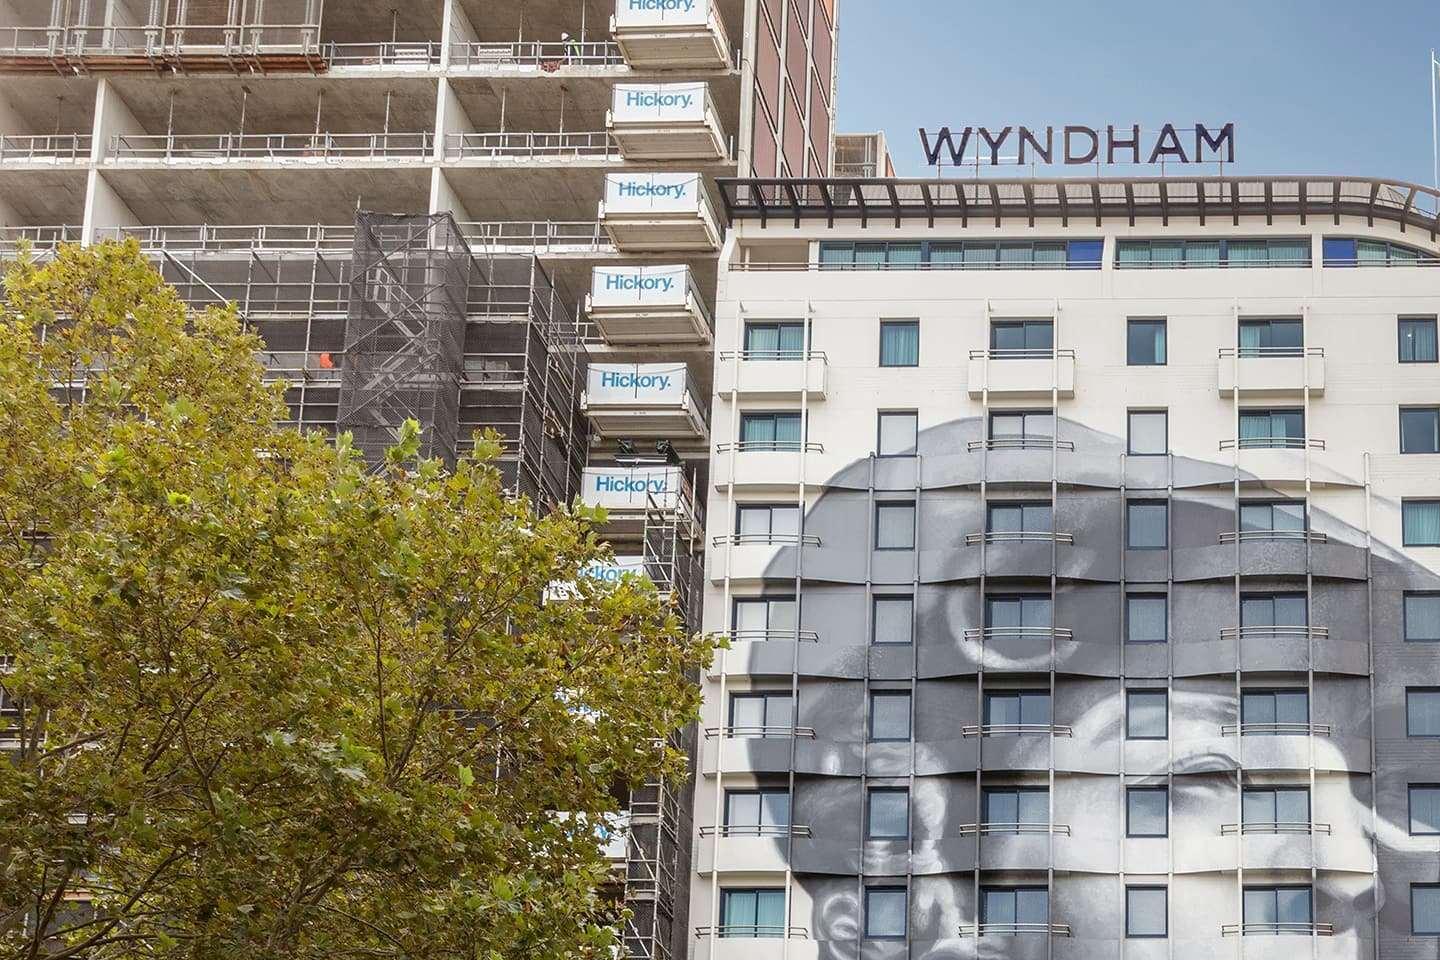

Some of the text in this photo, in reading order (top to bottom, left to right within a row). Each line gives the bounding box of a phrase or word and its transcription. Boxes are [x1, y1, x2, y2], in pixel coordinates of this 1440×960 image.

[629, 0, 695, 13] Hickory.
[626, 92, 693, 108] Hickory.
[919, 123, 1235, 166] WYNDHAM
[618, 182, 686, 199] Hickory.
[606, 275, 674, 292] Hickory.
[601, 372, 671, 390] Hickory.
[595, 476, 667, 495] Hickory.
